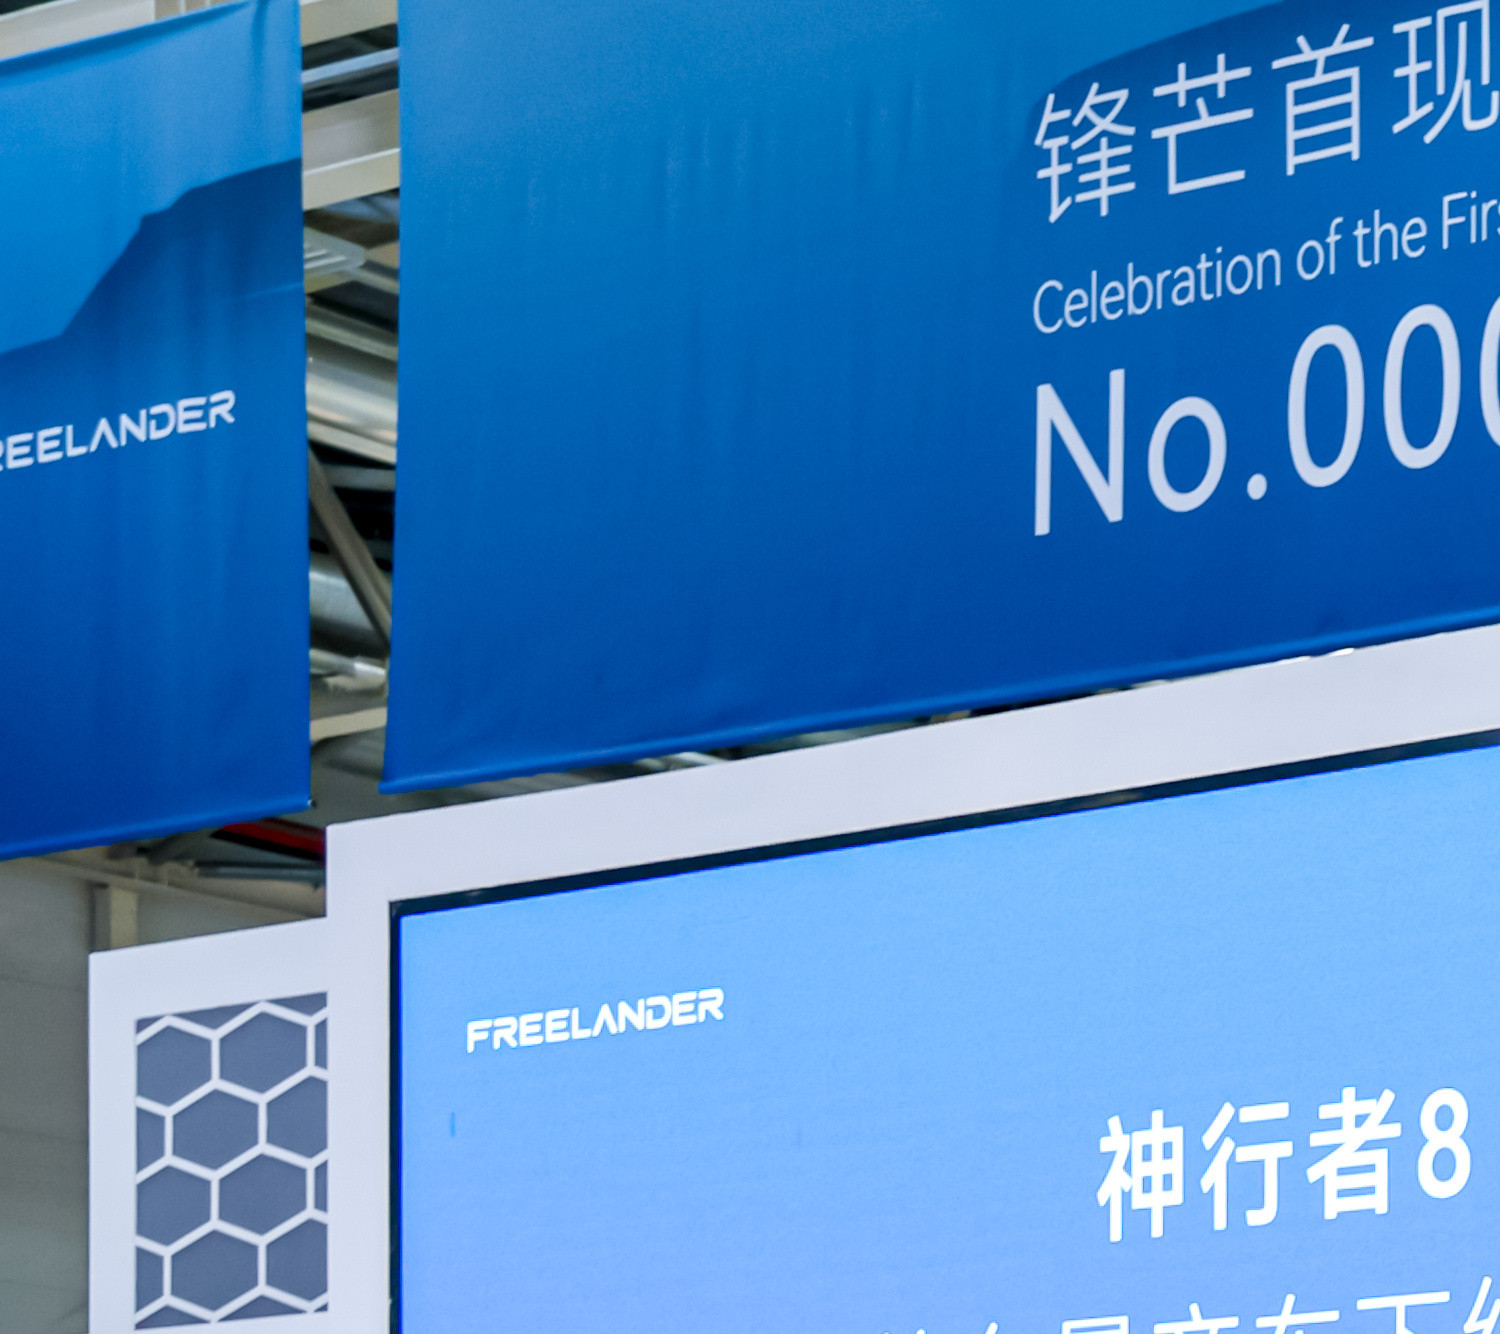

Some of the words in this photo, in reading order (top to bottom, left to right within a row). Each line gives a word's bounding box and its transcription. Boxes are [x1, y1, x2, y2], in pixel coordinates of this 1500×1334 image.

[1034, 3, 1500, 224] 锋芒首现
[1033, 246, 1281, 334] Celebration
[1296, 216, 1344, 281] of
[1352, 209, 1428, 268] the
[0, 390, 236, 472] EELANDER
[466, 988, 724, 1054] FREELANDER
[1097, 1086, 1471, 1242] 神行者8
